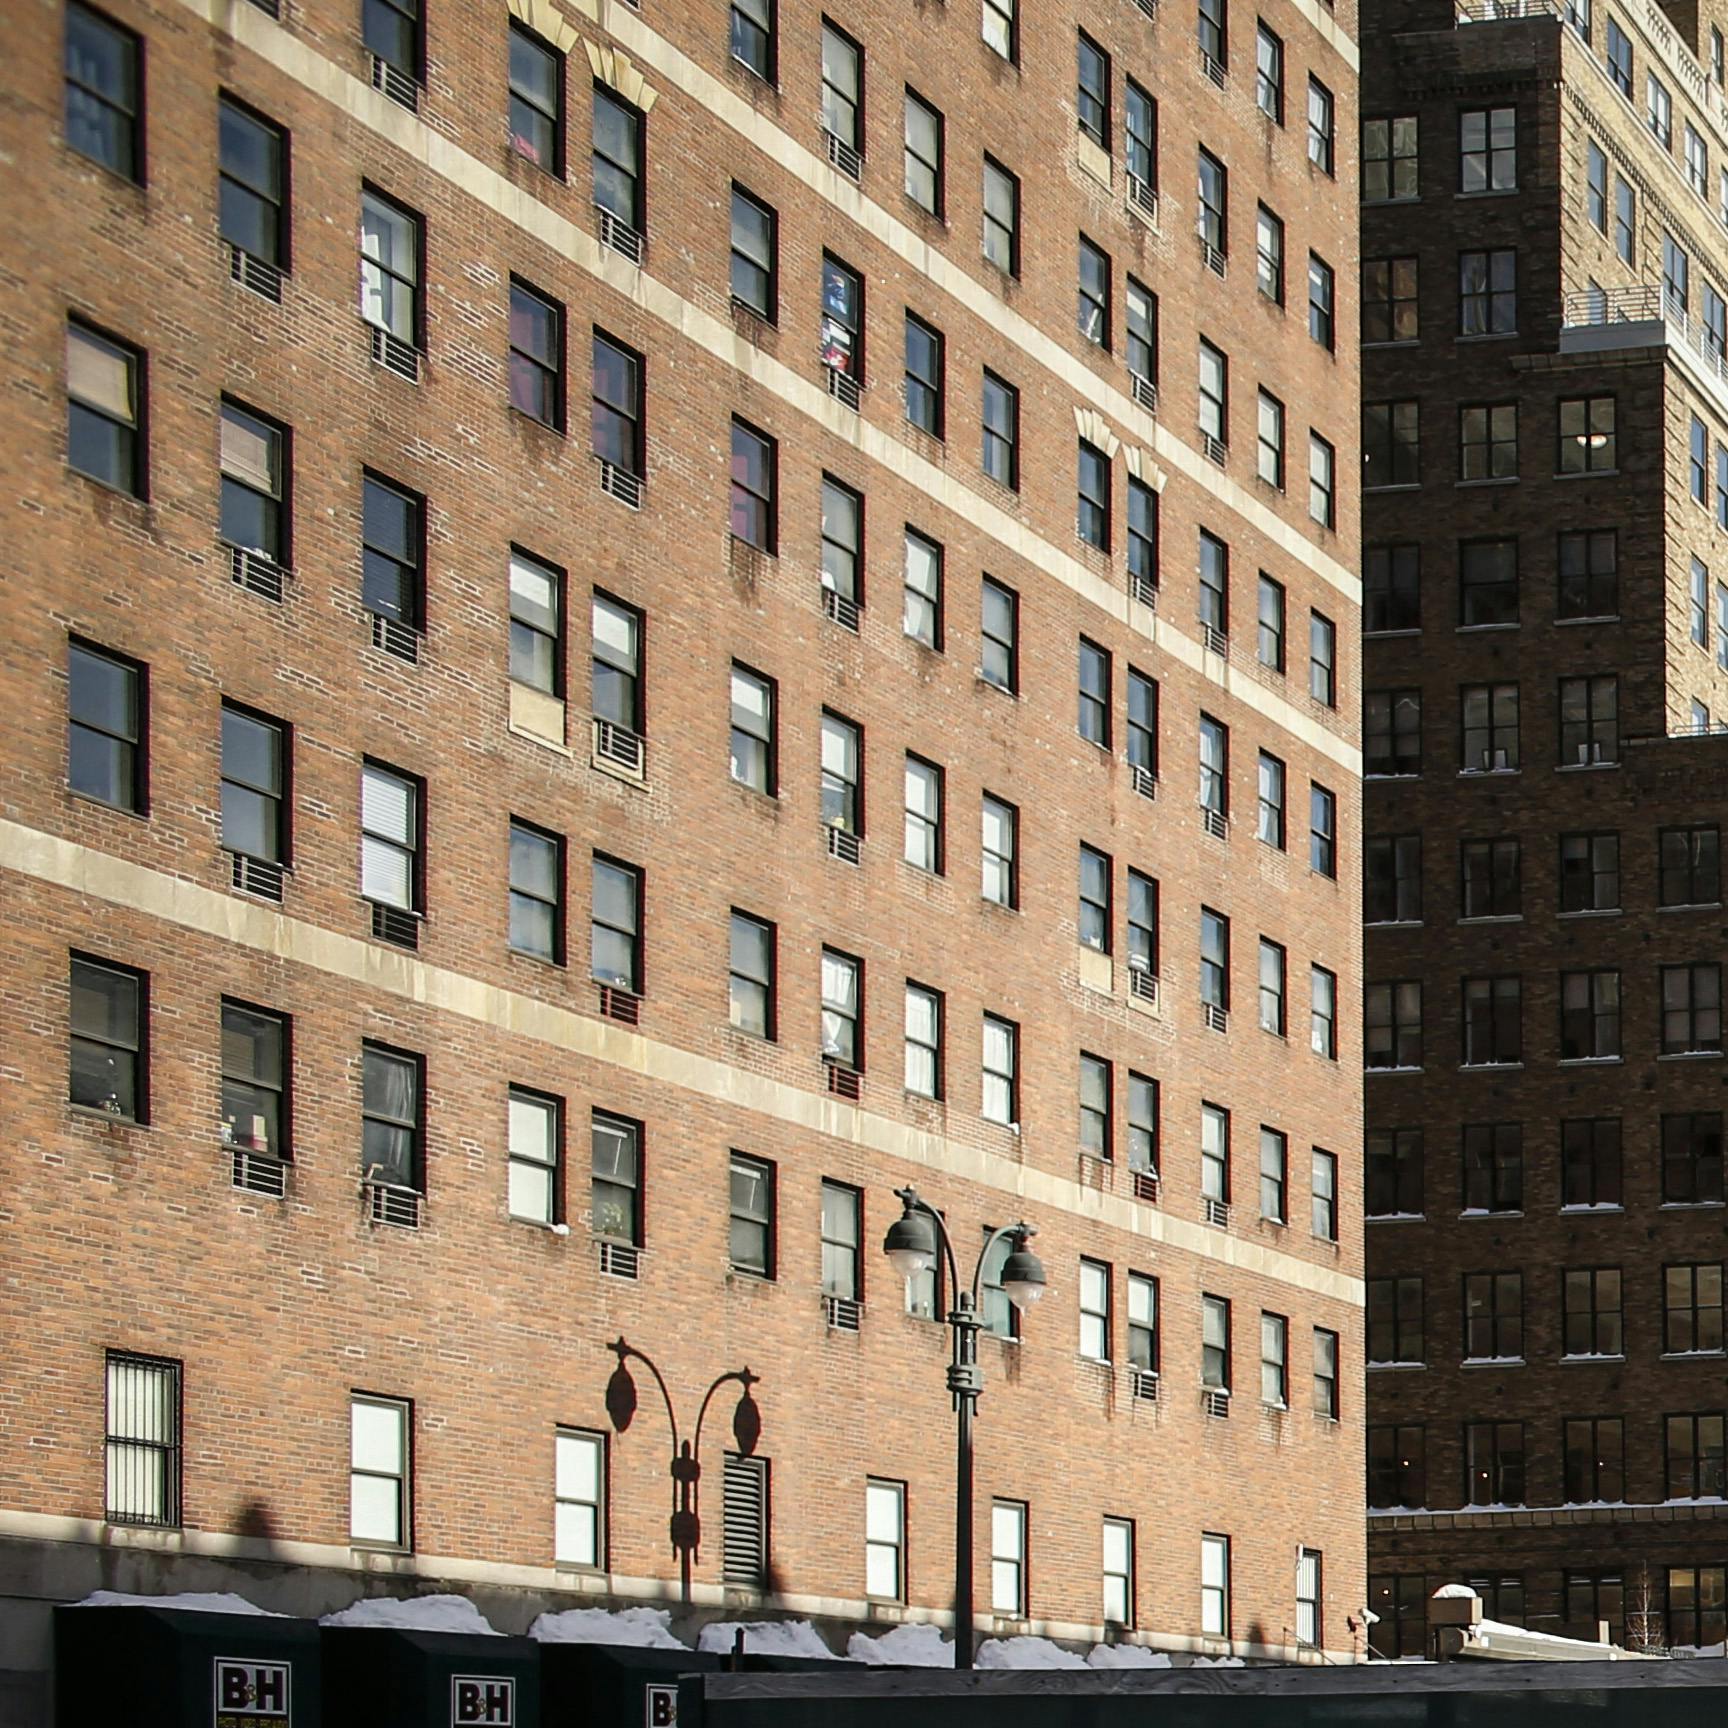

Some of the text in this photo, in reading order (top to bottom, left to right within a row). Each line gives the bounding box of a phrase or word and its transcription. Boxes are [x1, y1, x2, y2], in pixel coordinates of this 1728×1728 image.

[222, 1667, 284, 1711] B&H
[459, 1683, 509, 1722] B&H
[652, 1692, 677, 1727] B&
